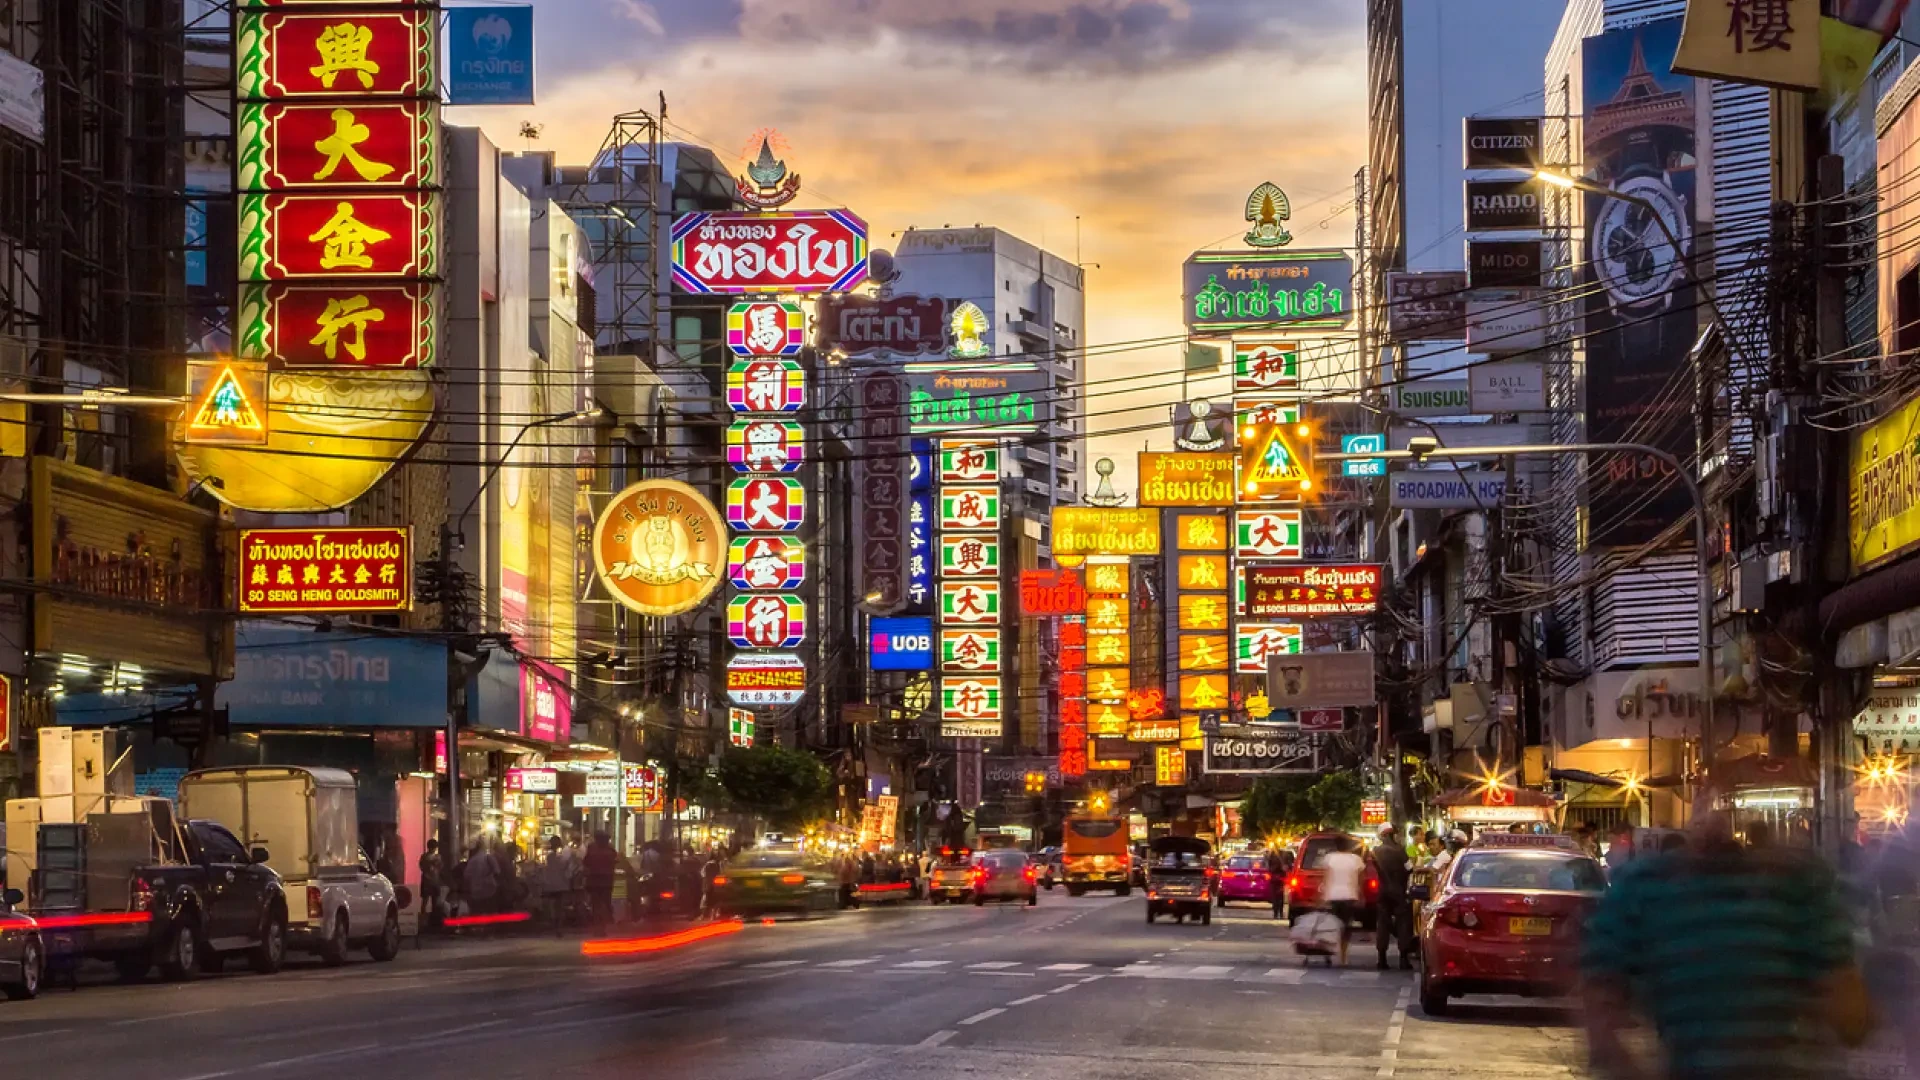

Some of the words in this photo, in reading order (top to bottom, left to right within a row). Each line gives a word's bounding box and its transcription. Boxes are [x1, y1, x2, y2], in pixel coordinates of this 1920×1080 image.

[1470, 135, 1534, 149] CITIZEN
[308, 22, 396, 360] 興大金行
[1472, 194, 1536, 209] RADO
[700, 219, 776, 240] ห้างทอง
[693, 223, 847, 279] ทองใบ
[1481, 255, 1529, 267] MIDO
[1489, 376, 1526, 387] BALL
[746, 306, 788, 642] 馬利興大金行
[1398, 481, 1473, 499] BROADWAY
[249, 589, 264, 601] SO
[268, 589, 297, 601] SENG
[302, 589, 331, 601] HENG
[337, 588, 398, 601] GOLDSMITH
[892, 635, 930, 650] UOB
[728, 671, 803, 686] EXCHANGE
